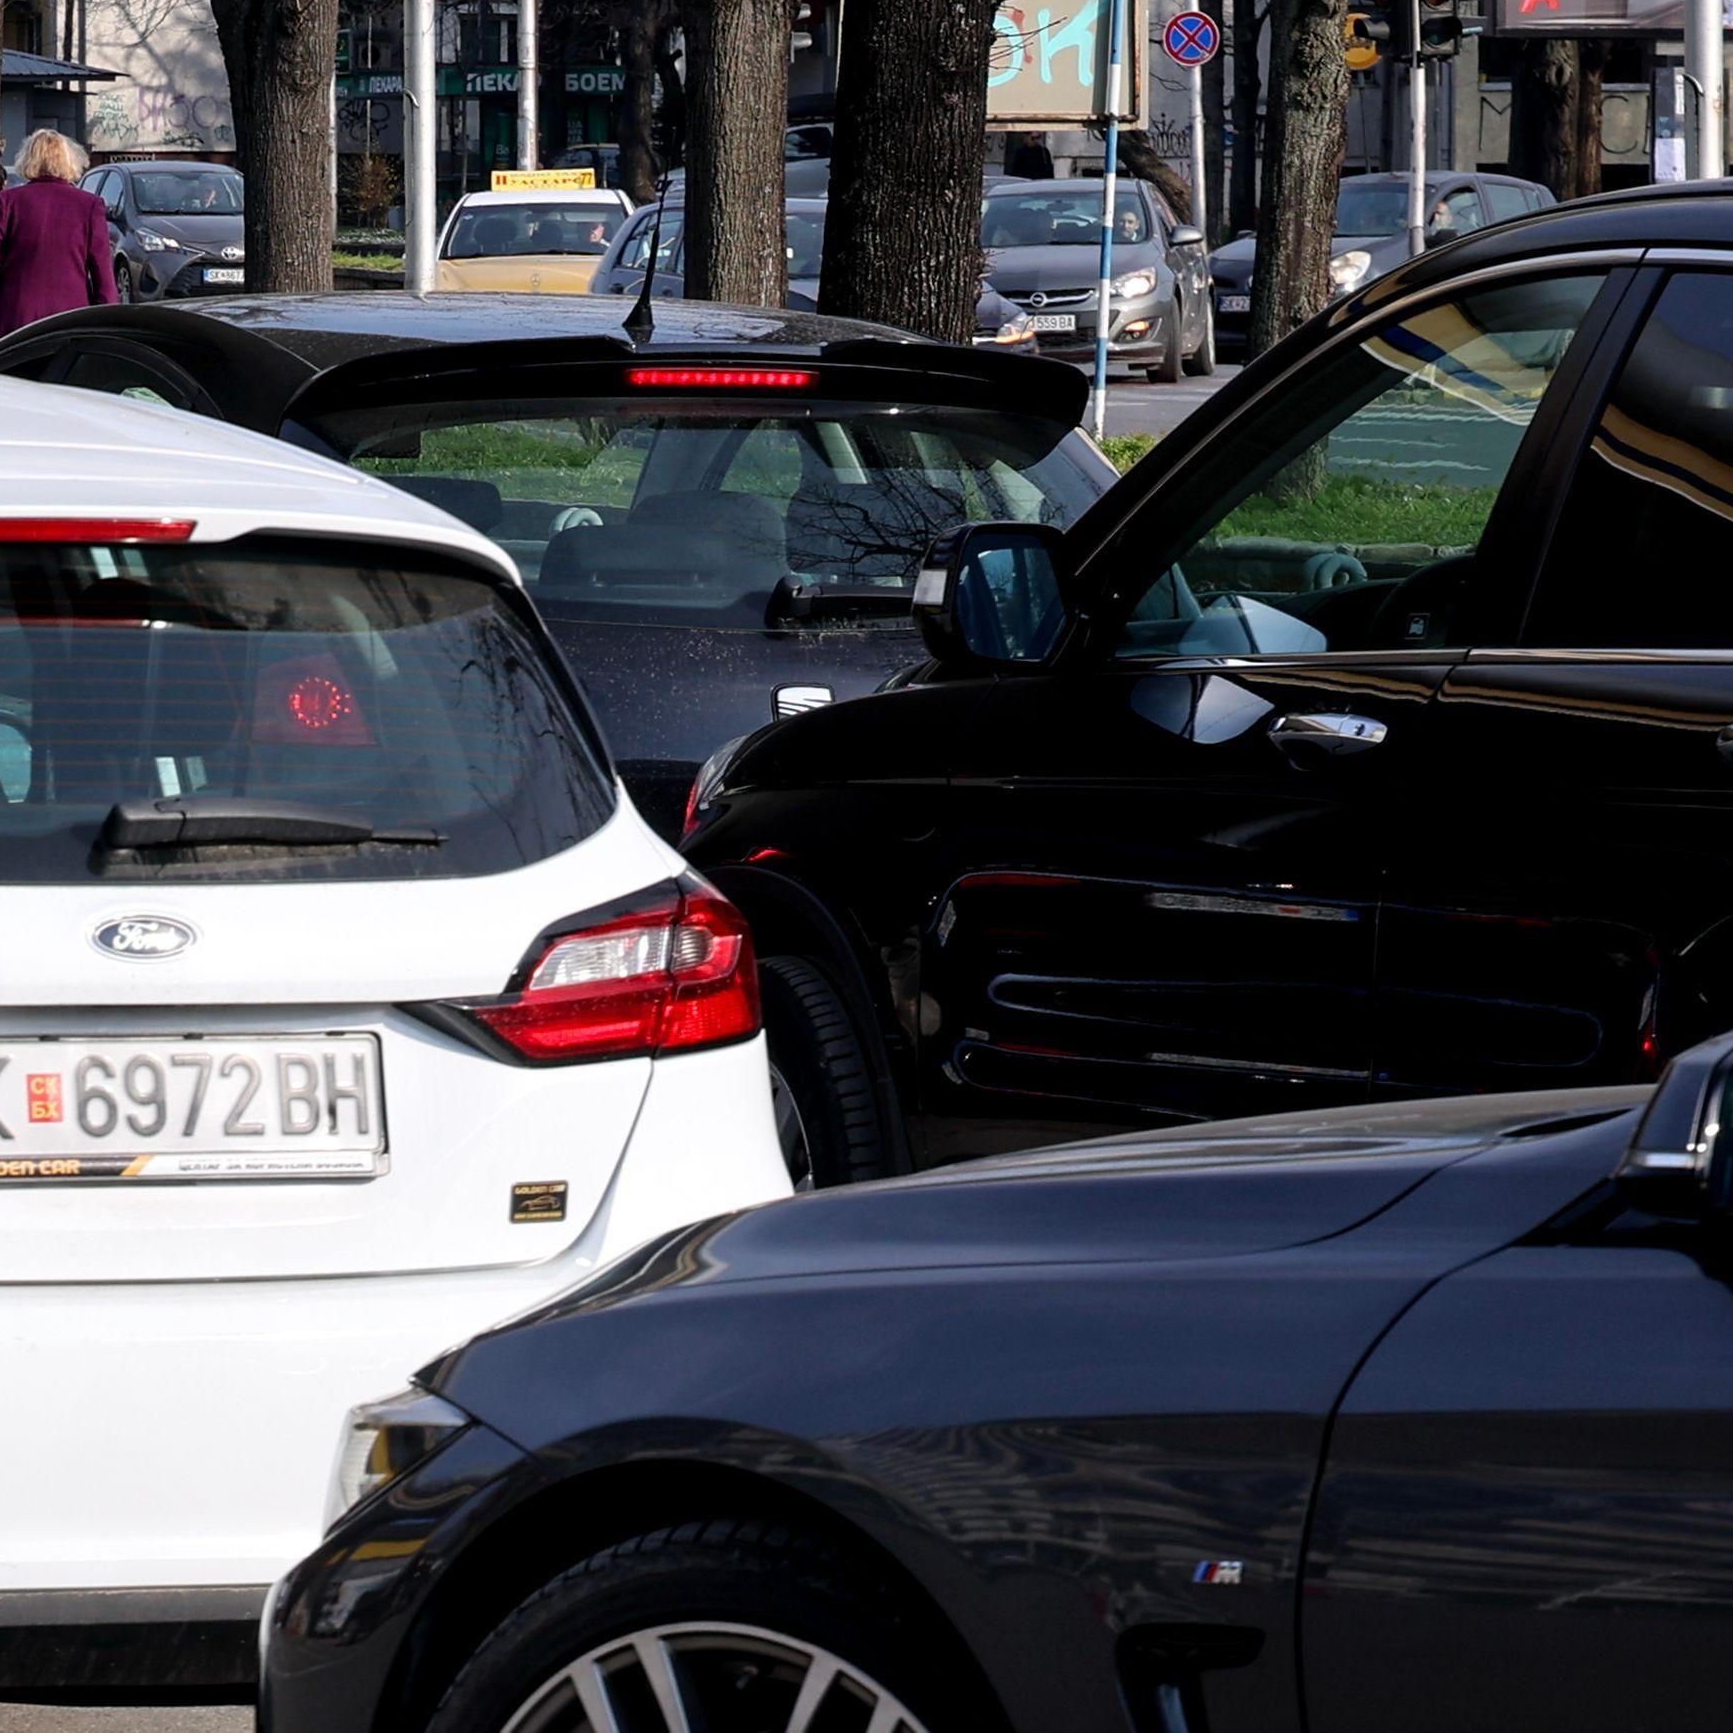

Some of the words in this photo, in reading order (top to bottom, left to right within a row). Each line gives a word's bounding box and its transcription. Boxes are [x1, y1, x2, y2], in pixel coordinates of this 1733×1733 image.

[112, 922, 181, 951] Ford
[77, 1052, 266, 1138] 6972
[274, 1051, 370, 1137] BH
[35, 1159, 81, 1175] CAR
